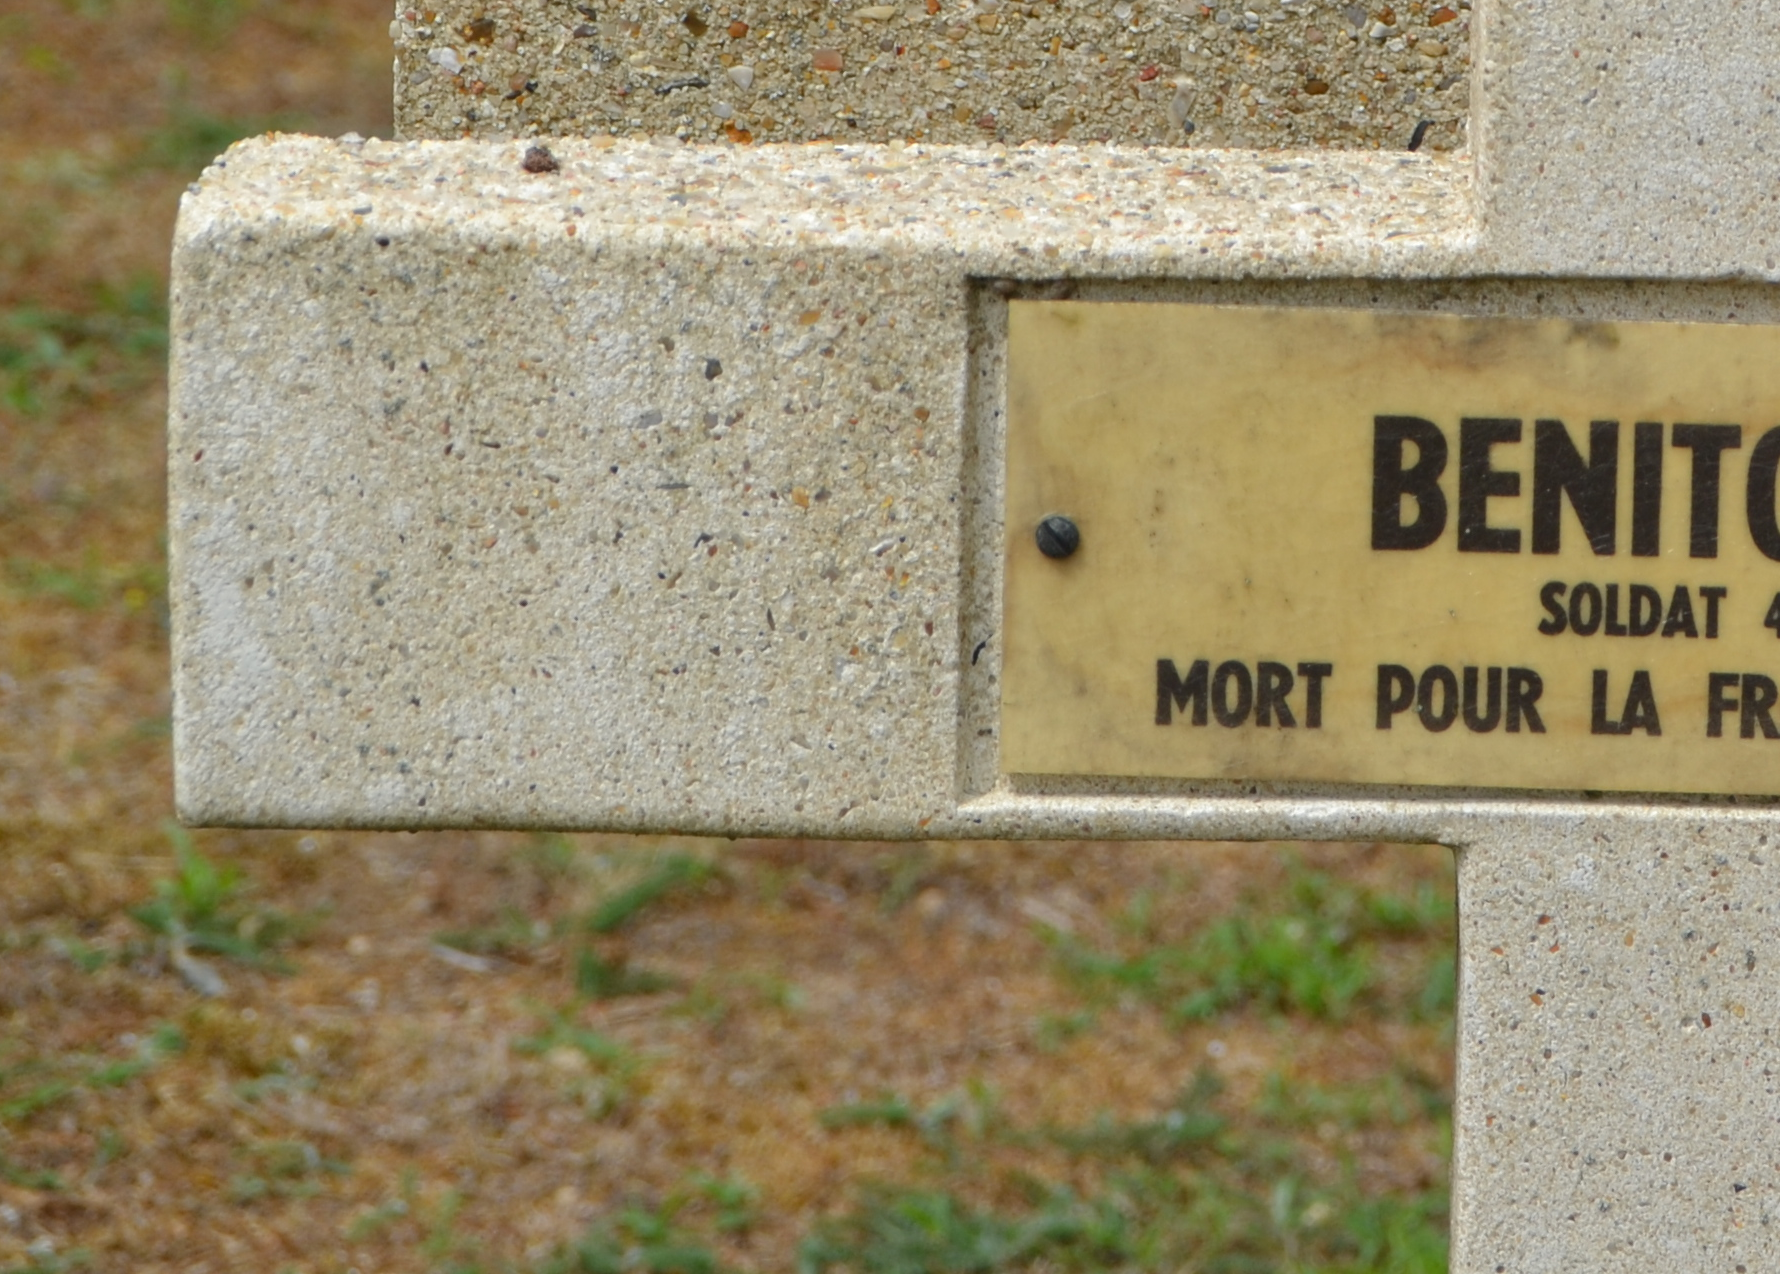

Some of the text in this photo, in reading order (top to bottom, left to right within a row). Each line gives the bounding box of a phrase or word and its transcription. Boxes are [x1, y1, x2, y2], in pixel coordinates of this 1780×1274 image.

[1537, 580, 1728, 640] SOLDAT
[1154, 658, 1333, 729] MORT
[1375, 663, 1547, 734] POUR
[1590, 669, 1662, 737] LA
